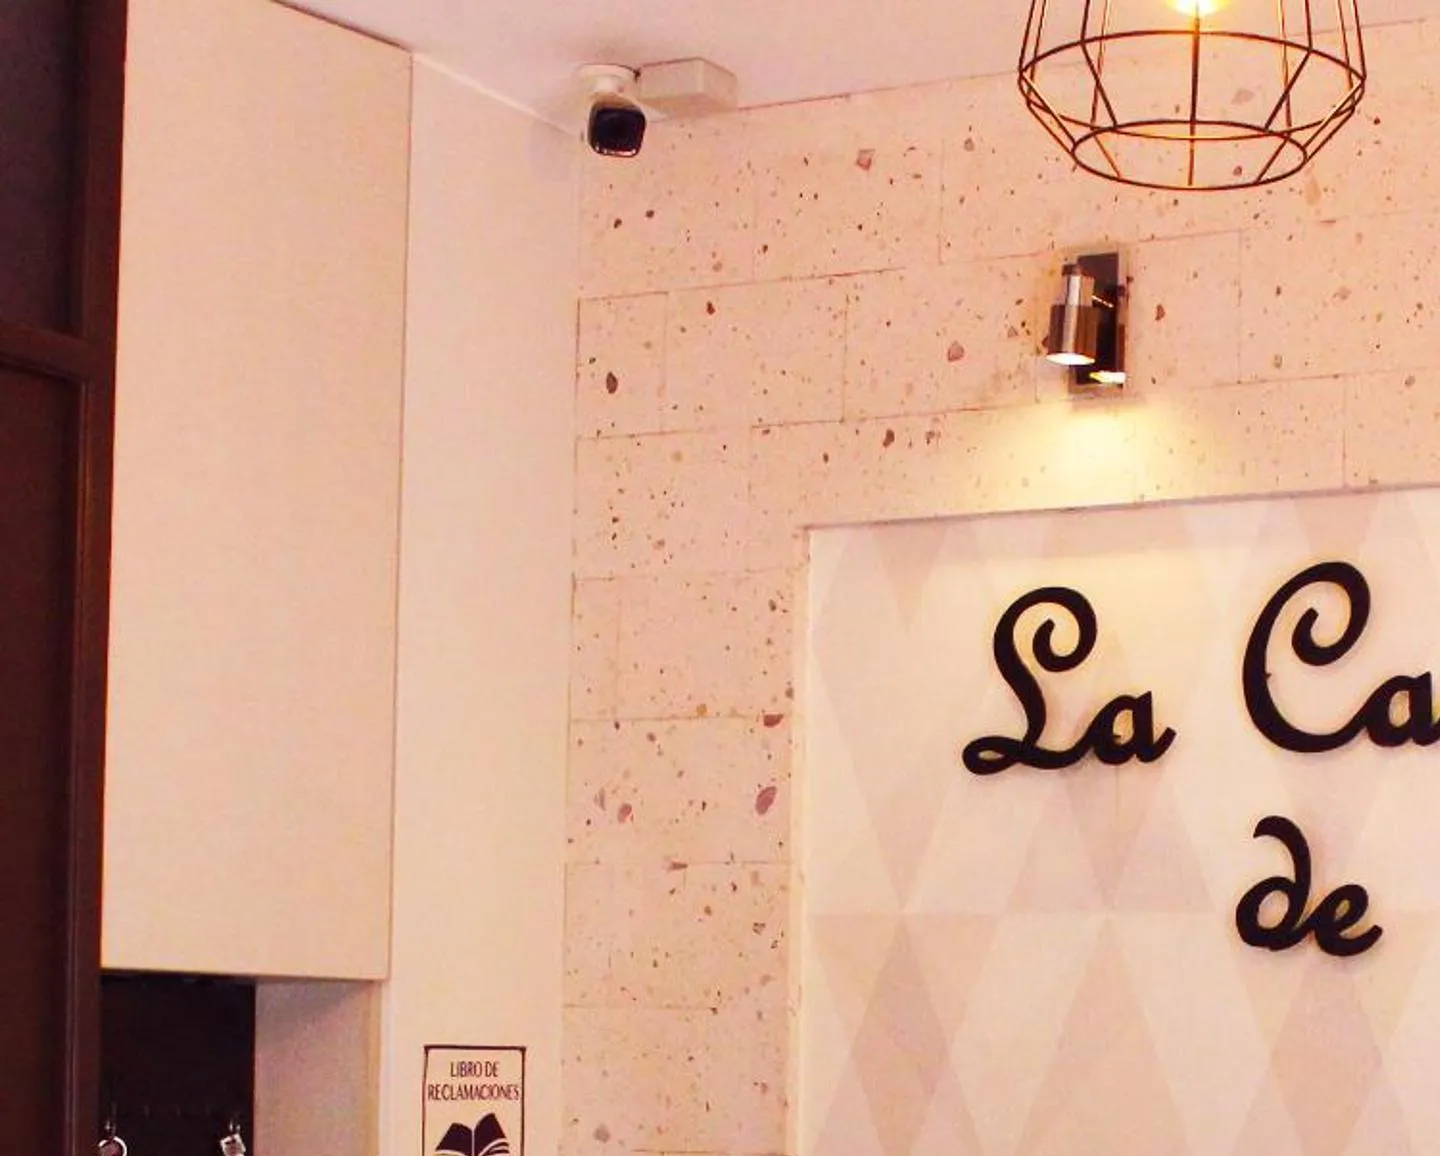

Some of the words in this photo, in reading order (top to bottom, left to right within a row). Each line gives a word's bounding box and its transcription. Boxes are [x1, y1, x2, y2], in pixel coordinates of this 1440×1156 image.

[962, 586, 1176, 775] La
[1235, 815, 1383, 958] de
[428, 1083, 519, 1101] RECLAMACIONES
[450, 1061, 482, 1077] LIBRO
[485, 1061, 500, 1077] DE
